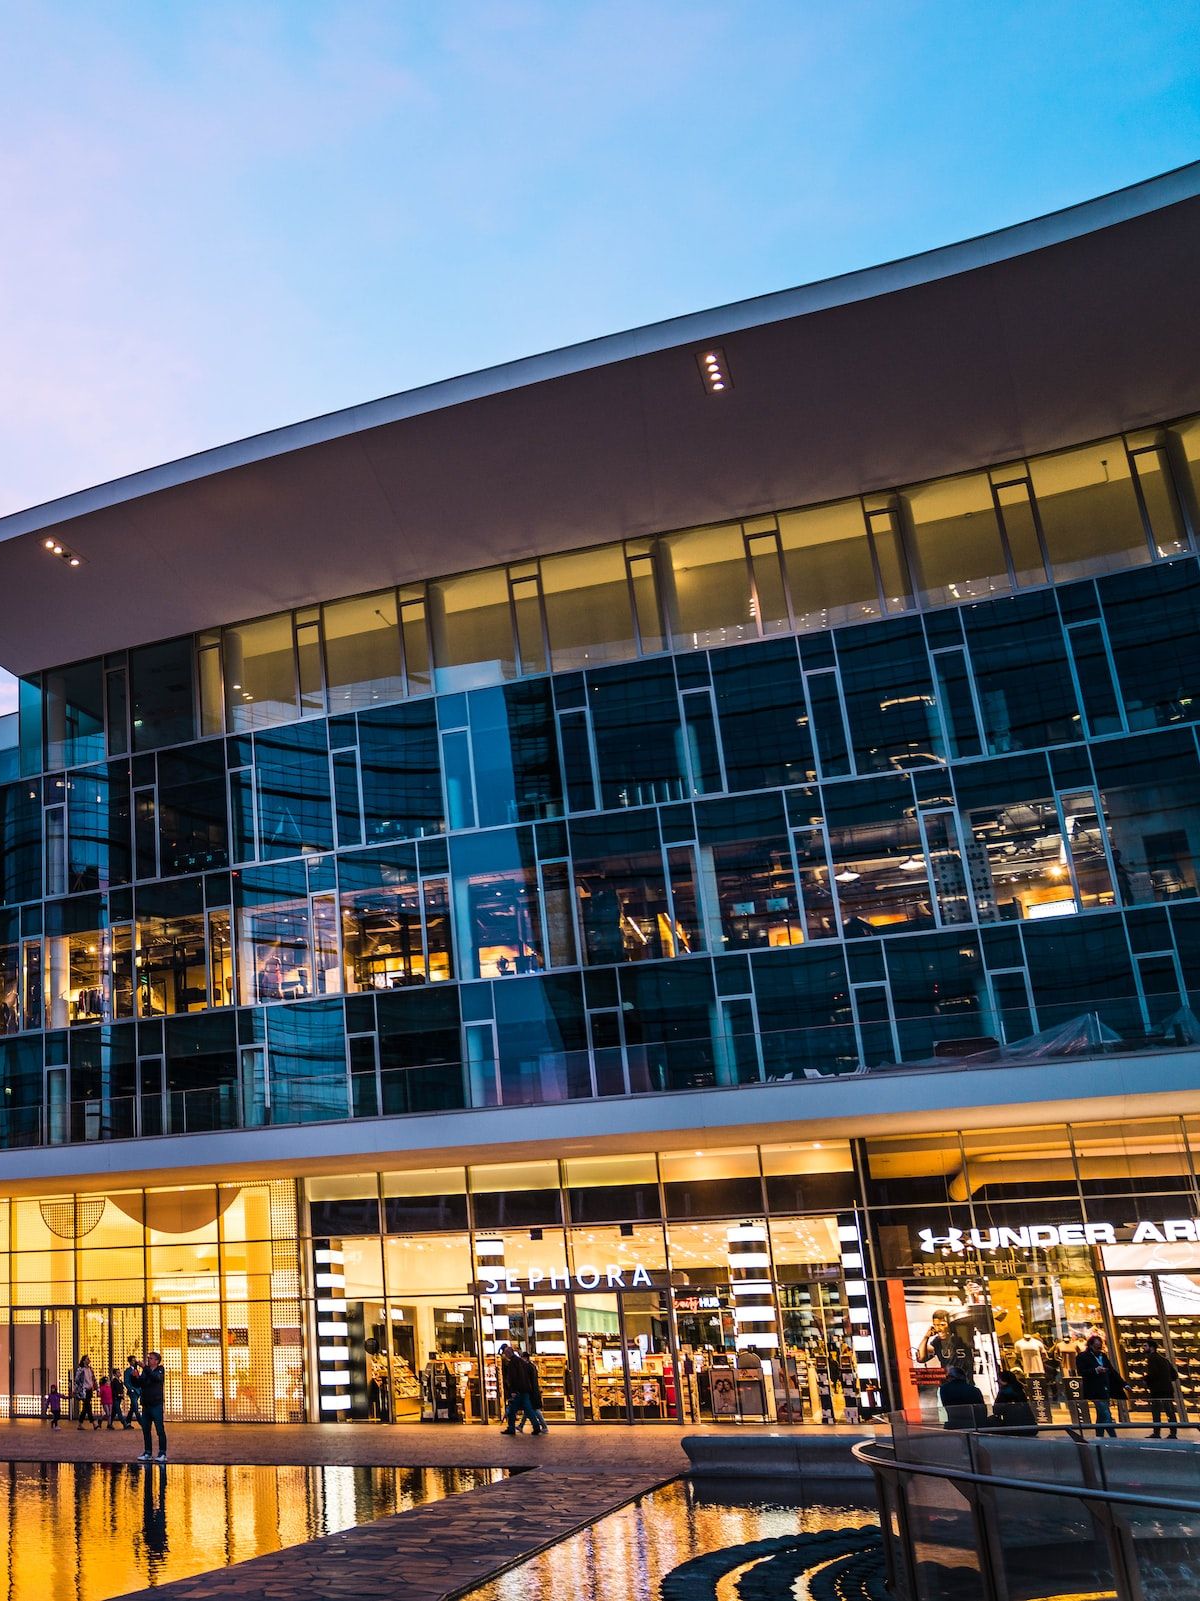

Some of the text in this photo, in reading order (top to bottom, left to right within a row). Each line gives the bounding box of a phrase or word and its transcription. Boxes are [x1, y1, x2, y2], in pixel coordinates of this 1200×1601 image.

[970, 1219, 1200, 1249] UNDER AR
[485, 1263, 652, 1293] SEPHORA
[699, 1297, 720, 1308] HUB
